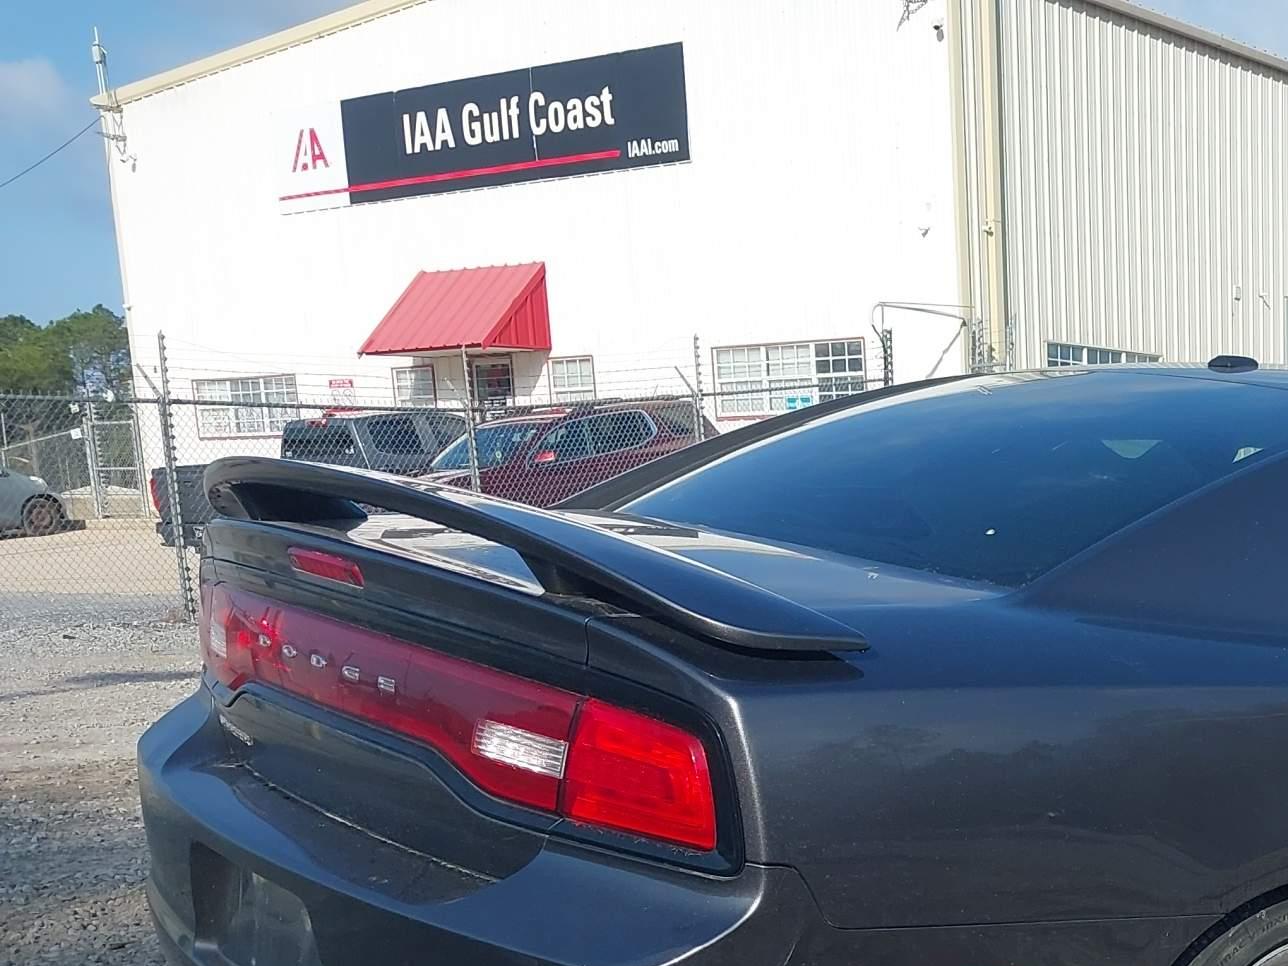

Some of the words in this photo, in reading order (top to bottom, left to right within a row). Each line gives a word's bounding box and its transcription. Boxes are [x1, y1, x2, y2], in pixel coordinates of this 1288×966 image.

[402, 107, 456, 155] IAA
[461, 95, 521, 146] Gulf
[528, 85, 615, 136] Coast
[626, 138, 680, 158] IAAI.com
[258, 633, 397, 695] DODGE
